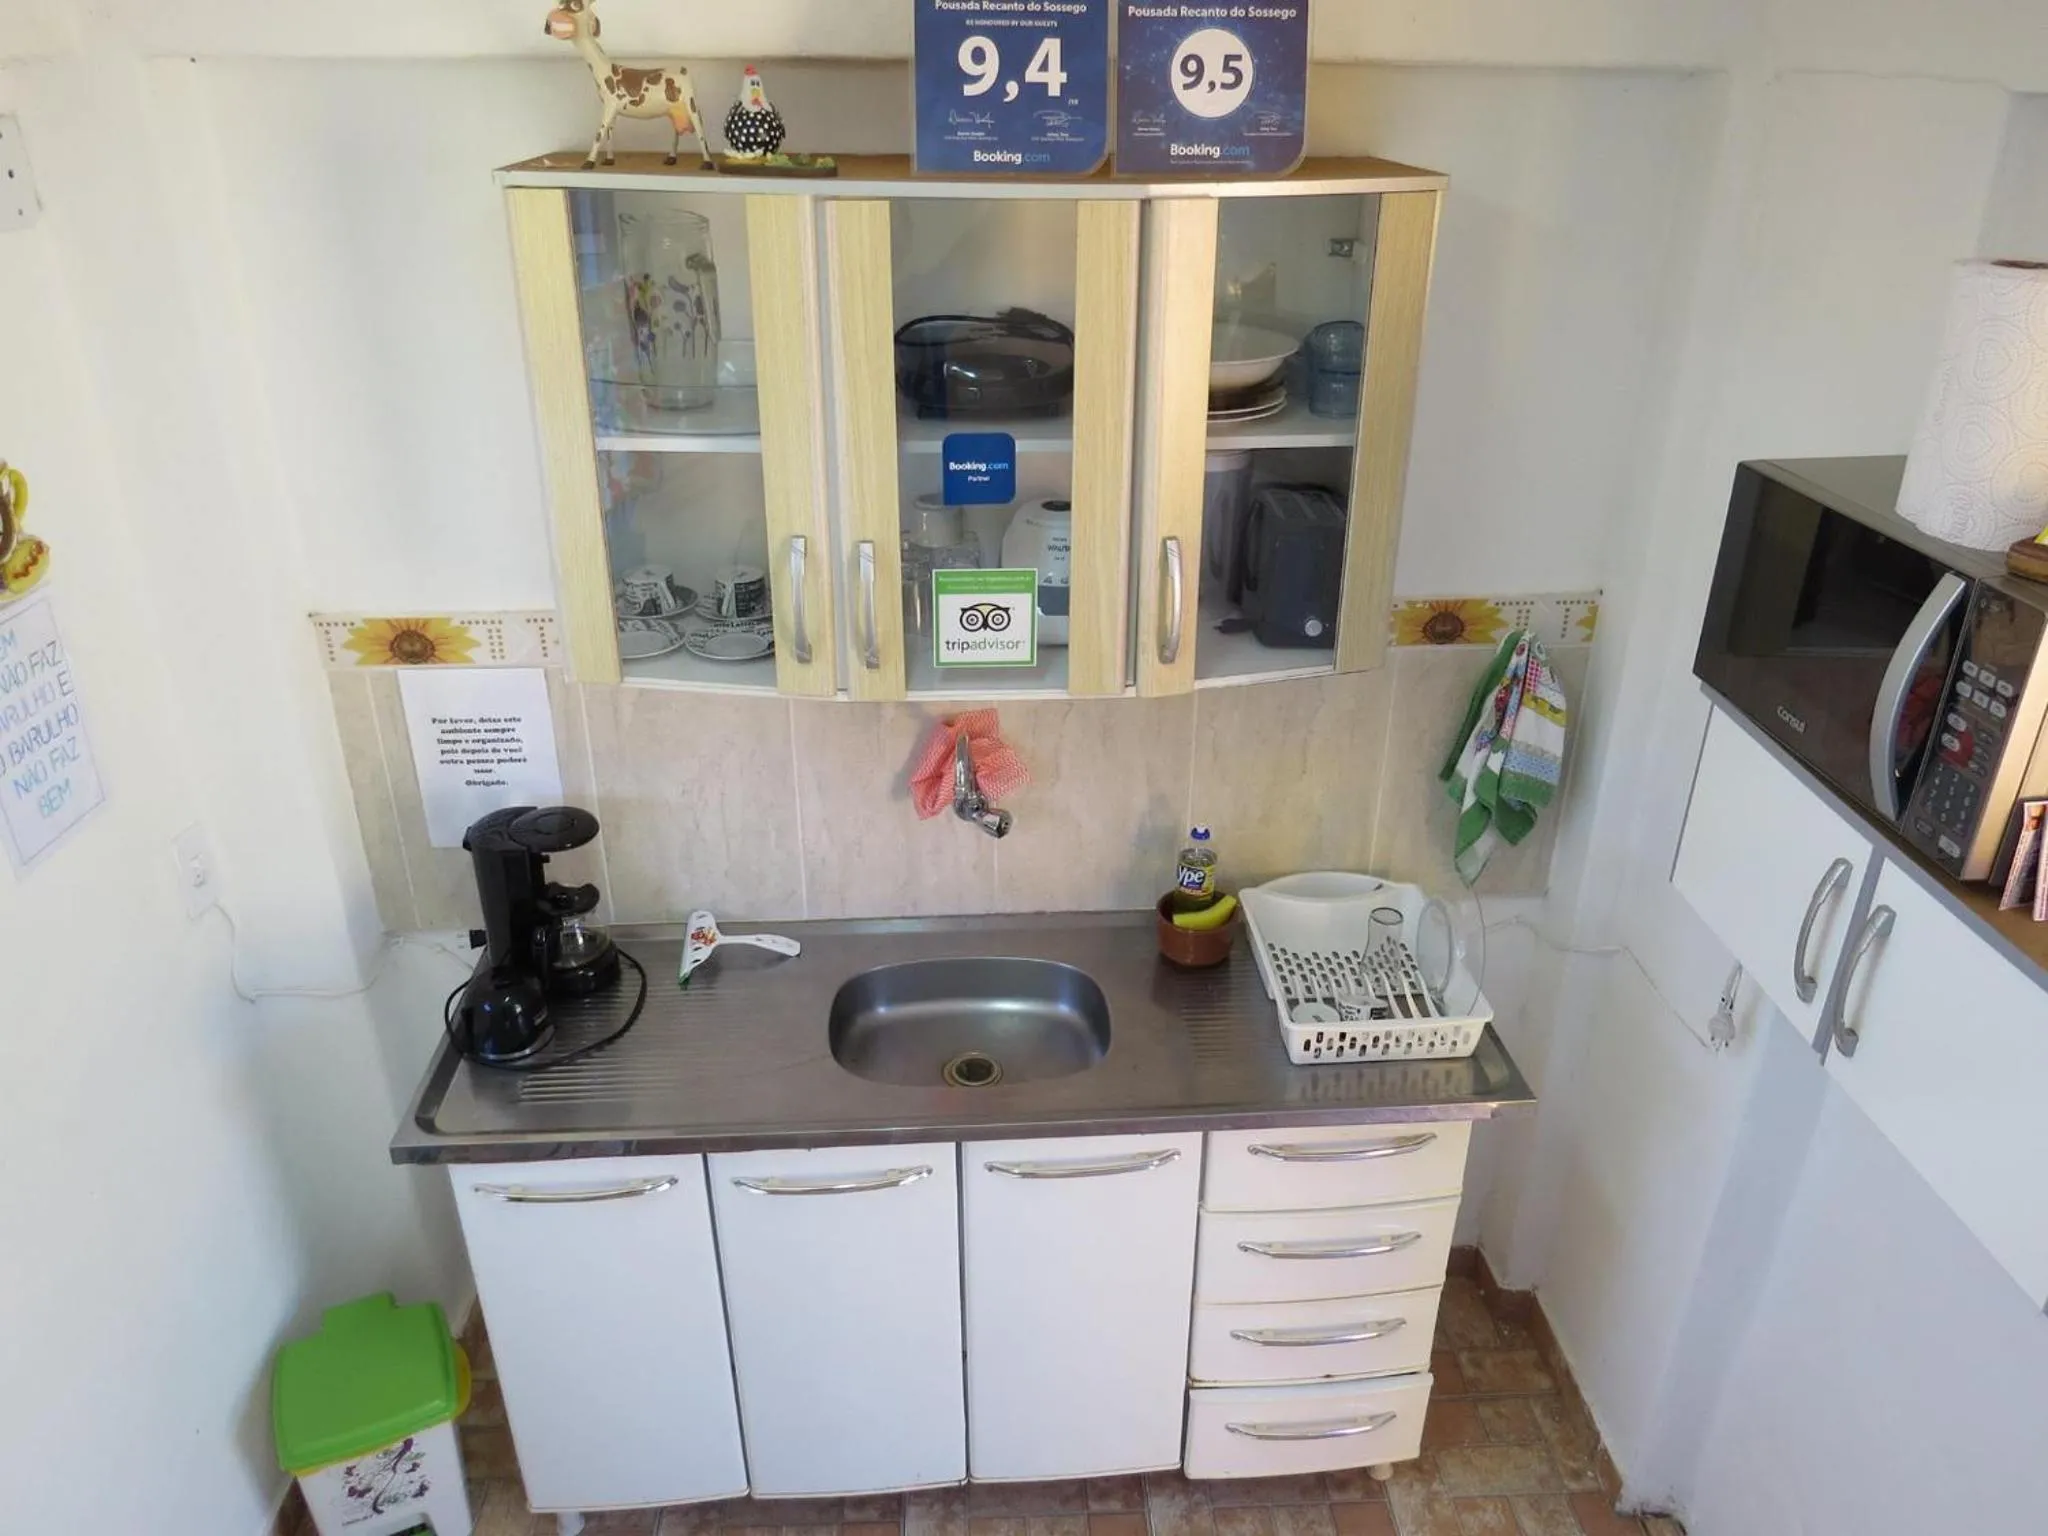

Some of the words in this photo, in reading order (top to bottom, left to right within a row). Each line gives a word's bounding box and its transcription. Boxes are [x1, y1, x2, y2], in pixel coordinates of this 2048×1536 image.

[935, 0, 980, 11] Pousada
[982, 0, 1025, 12] Recanto
[1027, 1, 1043, 12] do
[1044, 1, 1087, 15] Sossego
[1128, 6, 1177, 17] Pousada
[1180, 6, 1227, 18] Recanto
[1229, 6, 1246, 18] do
[1248, 7, 1297, 20] Sossego
[957, 35, 1068, 102] 9,4
[1179, 53, 1244, 93] 9,5
[973, 150, 1050, 164] Booking.com
[1170, 143, 1250, 158] Booking.com
[949, 461, 1008, 472] Booking.com
[945, 637, 1021, 653] tripadvisor
[29, 640, 62, 677] FAZ
[57, 670, 74, 697] E
[9, 702, 79, 766] BARULHO
